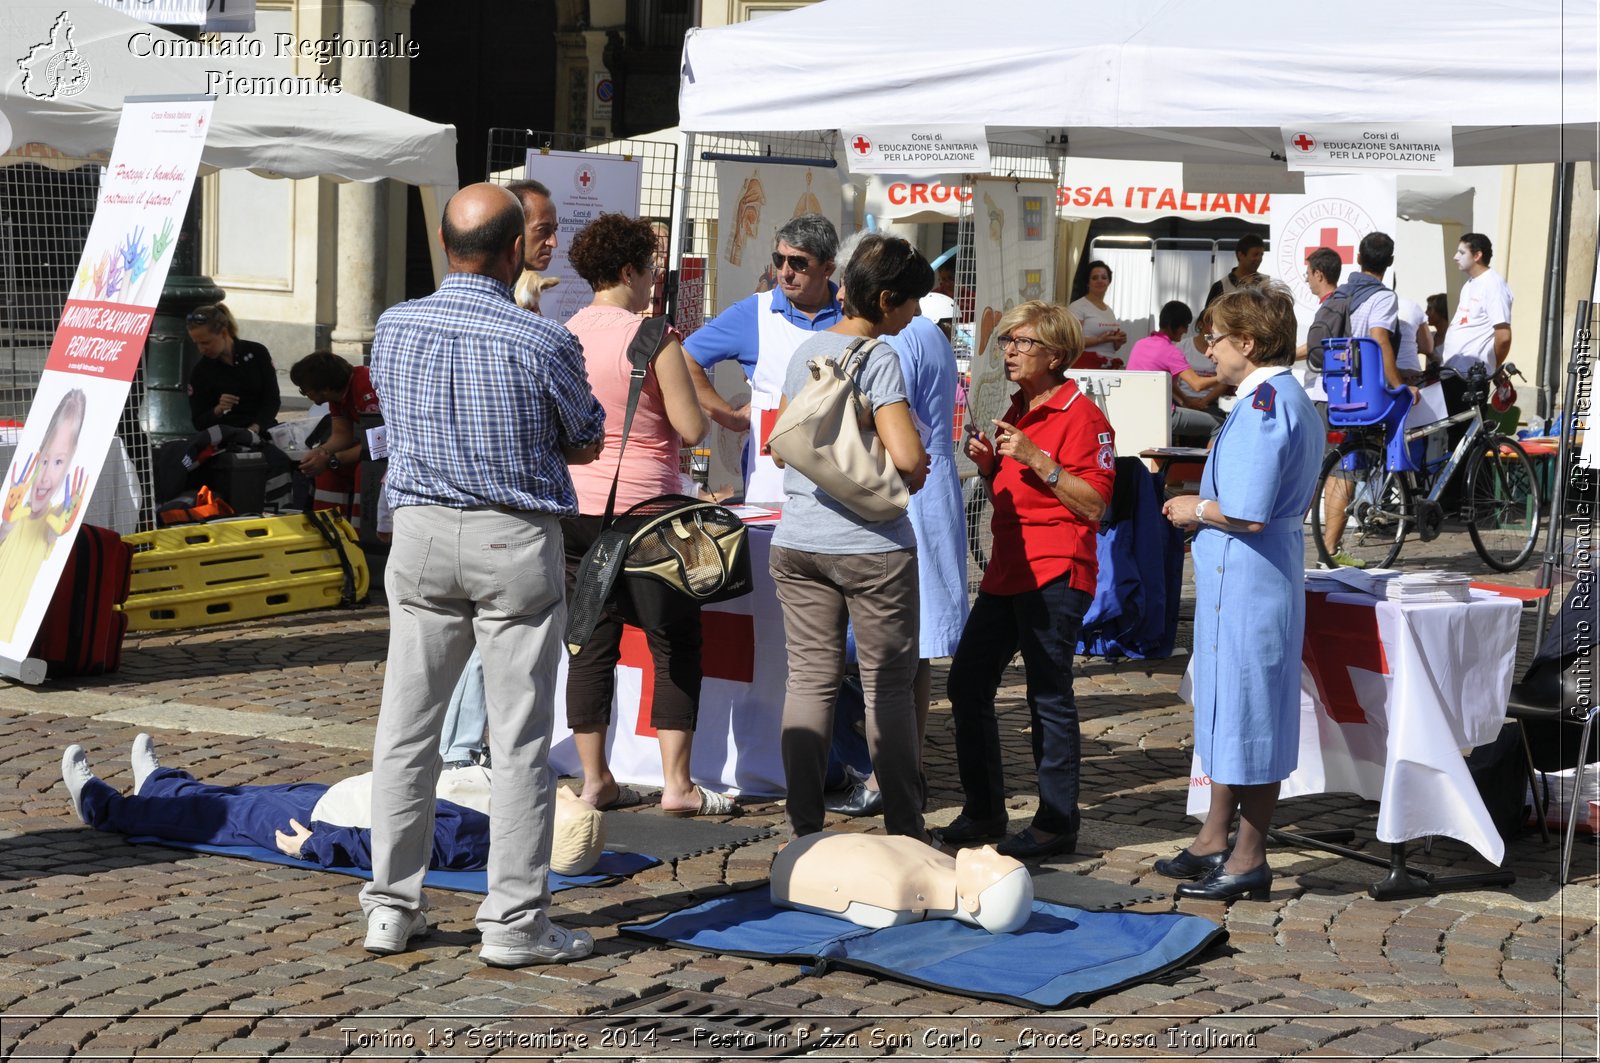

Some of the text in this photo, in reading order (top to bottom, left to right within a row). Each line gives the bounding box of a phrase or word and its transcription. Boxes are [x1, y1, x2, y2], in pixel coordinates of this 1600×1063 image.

[911, 133, 943, 141] Corsi di
[1363, 131, 1400, 140] Corsi di
[878, 143, 979, 152] EDUCAZIONE SANITARIA
[1323, 141, 1441, 152] EDUCAZIONE SANITARIA
[884, 153, 901, 161] PER
[903, 153, 914, 161] LA
[915, 153, 975, 161] POPOLAZIONE
[1330, 151, 1436, 162] PER LA POPOLAZIONE
[1125, 186, 1270, 215] ITALIANA
[1309, 202, 1361, 226] GINEVRA
[96, 308, 151, 336] SALVAVITA
[65, 335, 128, 361] PEDIATRICHE
